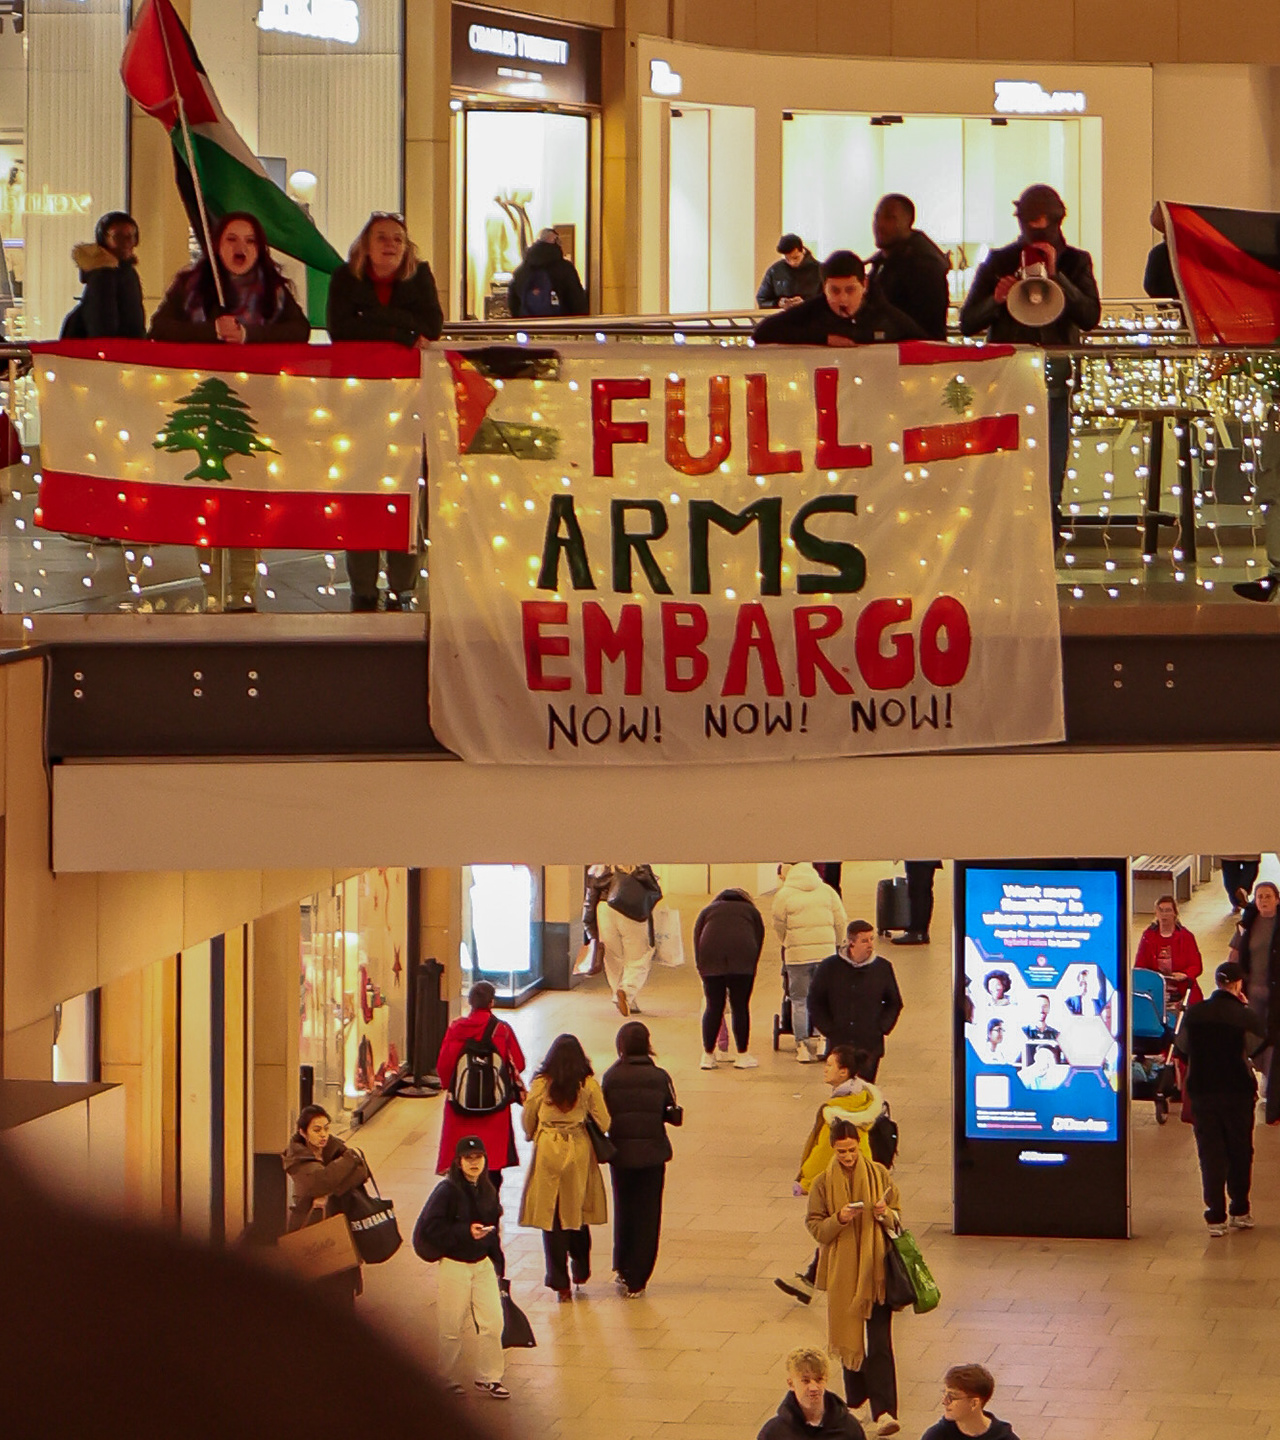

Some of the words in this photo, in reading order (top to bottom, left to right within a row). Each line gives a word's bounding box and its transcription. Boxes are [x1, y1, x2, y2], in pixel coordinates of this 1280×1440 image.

[591, 366, 873, 478] FULL
[536, 492, 868, 597] ARMS
[520, 593, 973, 698] EMBARGO
[547, 702, 663, 750] NOW!
[703, 698, 810, 739] NOW!
[850, 691, 955, 733] NOW!
